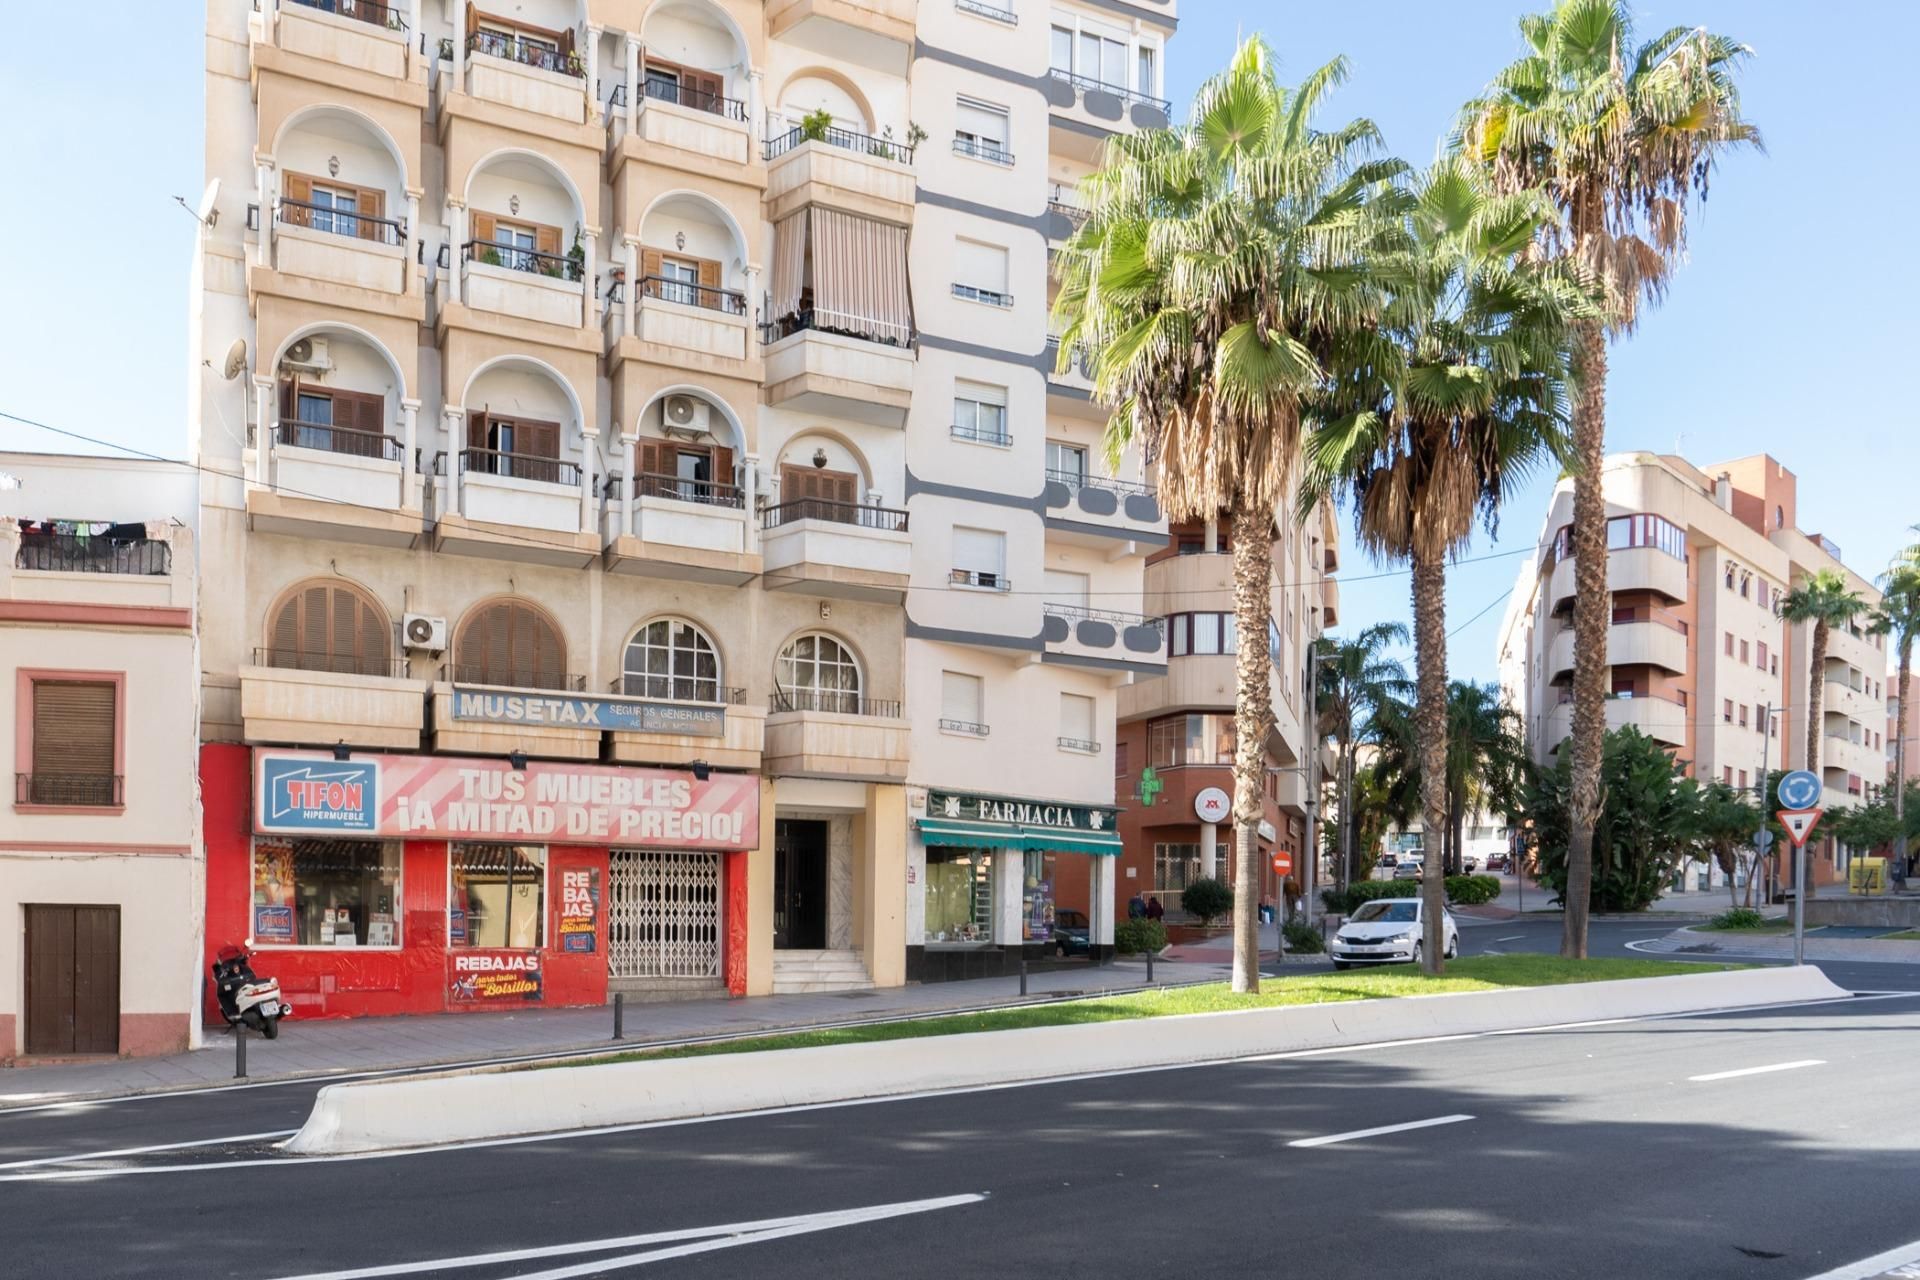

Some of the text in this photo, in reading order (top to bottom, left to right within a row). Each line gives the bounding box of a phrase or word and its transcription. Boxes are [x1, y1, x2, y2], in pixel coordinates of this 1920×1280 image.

[460, 693, 600, 724] MUSETAX
[661, 708, 717, 721] GENERALES
[287, 780, 363, 811] TIFON
[459, 768, 691, 808] TUS MUEBLES
[303, 810, 364, 821] HIPERMUEBLE
[397, 796, 743, 843] ¡A MITAD DE PRECIO!
[979, 800, 1075, 827] FARMACIA
[563, 871, 589, 887] RE
[563, 888, 591, 903] BA
[562, 903, 594, 917] JAS
[456, 956, 538, 971] REBAJAS
[496, 973, 517, 982] todos
[484, 981, 538, 996] Bolsillos
